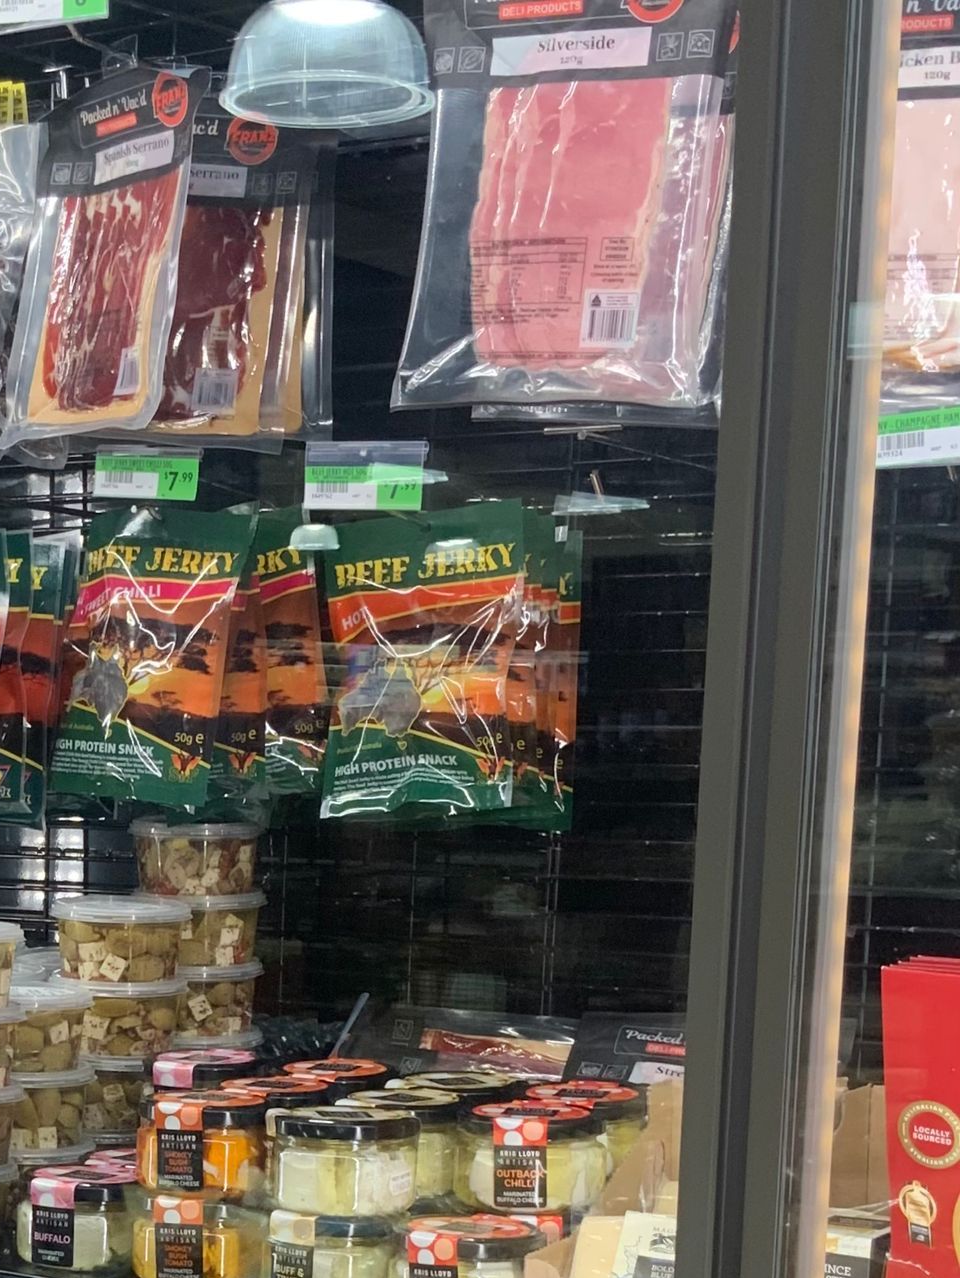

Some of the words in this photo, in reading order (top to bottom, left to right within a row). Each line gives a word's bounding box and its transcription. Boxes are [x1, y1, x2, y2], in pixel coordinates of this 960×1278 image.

[527, 2, 582, 16] PRODUCTS
[538, 36, 615, 54] Silverside
[80, 101, 112, 126] Packed
[103, 146, 132, 164] Spanish
[164, 470, 194, 491] $7.99
[88, 546, 141, 574] BEEF
[145, 547, 239, 576] JERKY
[335, 556, 410, 589] BEEF
[418, 543, 515, 579] JERKY
[114, 585, 161, 599] CHILLI
[341, 606, 368, 631] HOT
[174, 732, 193, 746] 50g
[74, 740, 117, 754] PROTEIN
[335, 763, 360, 778] HIGH
[362, 755, 416, 774] PROTEIN
[418, 754, 458, 768] SNACK
[626, 1028, 683, 1045] Packed
[913, 1125, 950, 1137] LOCALLY
[912, 1132, 952, 1146] SOURCED
[496, 1169, 544, 1178] OUTBACK
[504, 1178, 537, 1188] CHILLI
[34, 1231, 71, 1244] BUFFALO
[276, 1264, 296, 1277] BUFF
[651, 1264, 674, 1272] BOLD
